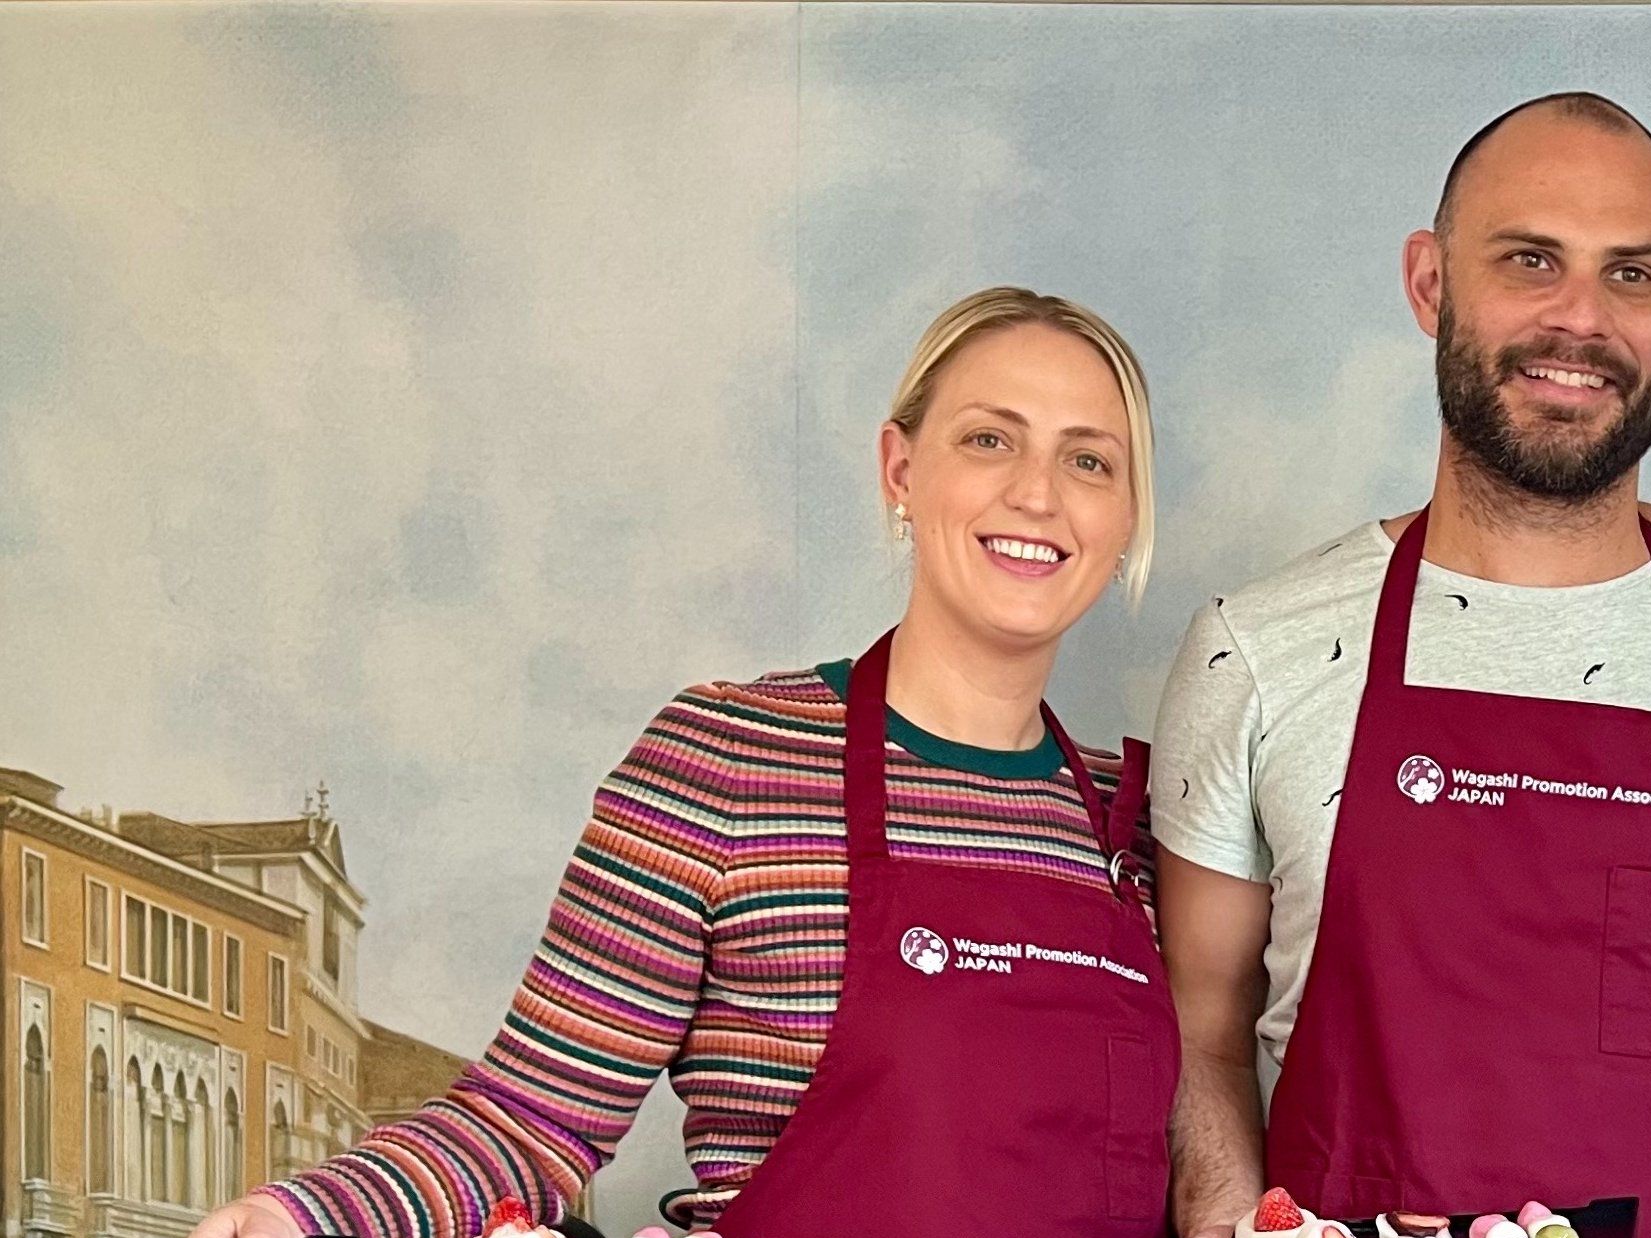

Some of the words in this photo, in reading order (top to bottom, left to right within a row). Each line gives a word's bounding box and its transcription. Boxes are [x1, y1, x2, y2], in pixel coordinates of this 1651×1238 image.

[1451, 768, 1518, 789] Wagashi
[1521, 775, 1608, 800] Promotion
[1448, 787, 1505, 807] JAPAN
[953, 937, 1022, 959] Wagashi
[1025, 944, 1098, 968] Promotion
[955, 955, 1012, 974] JAPAN
